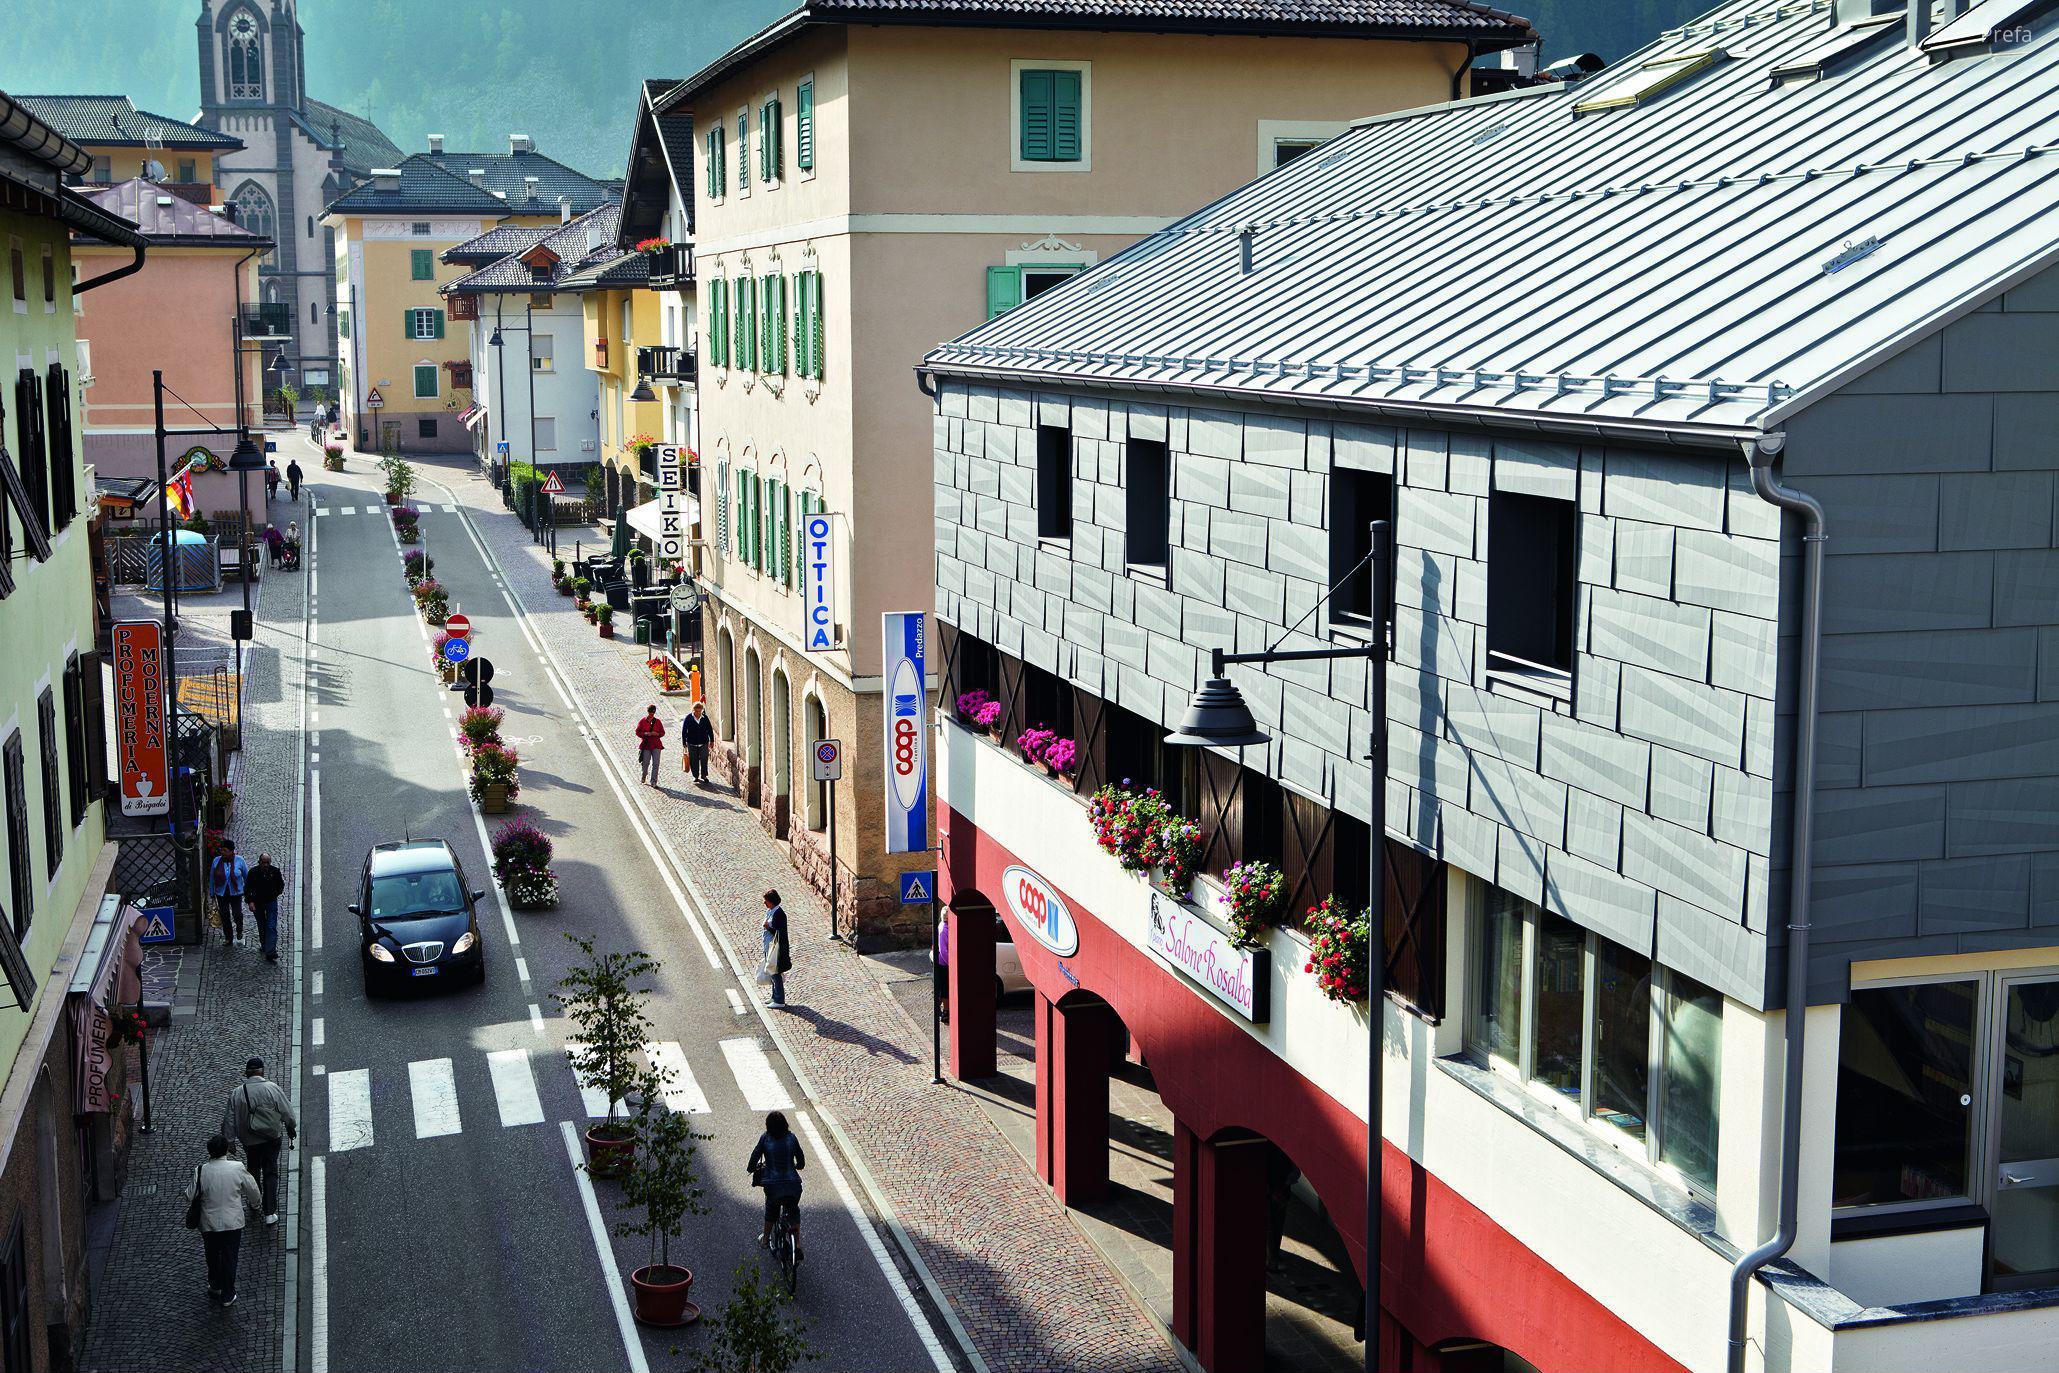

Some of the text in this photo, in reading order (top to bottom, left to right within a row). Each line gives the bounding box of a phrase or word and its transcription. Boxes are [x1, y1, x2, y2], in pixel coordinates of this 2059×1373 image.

[662, 448, 679, 555] SEIKO
[809, 518, 830, 648] OTTICA
[915, 618, 923, 658] Predazzo
[118, 630, 140, 774] PROFUMERIA
[141, 648, 161, 749] MODERNA
[895, 718, 917, 776] coop
[124, 800, 133, 810] di
[1019, 878, 1047, 929] coop
[1165, 915, 1251, 1009] Salone Rosalba
[88, 1006, 108, 1107] PROFUMERIA
